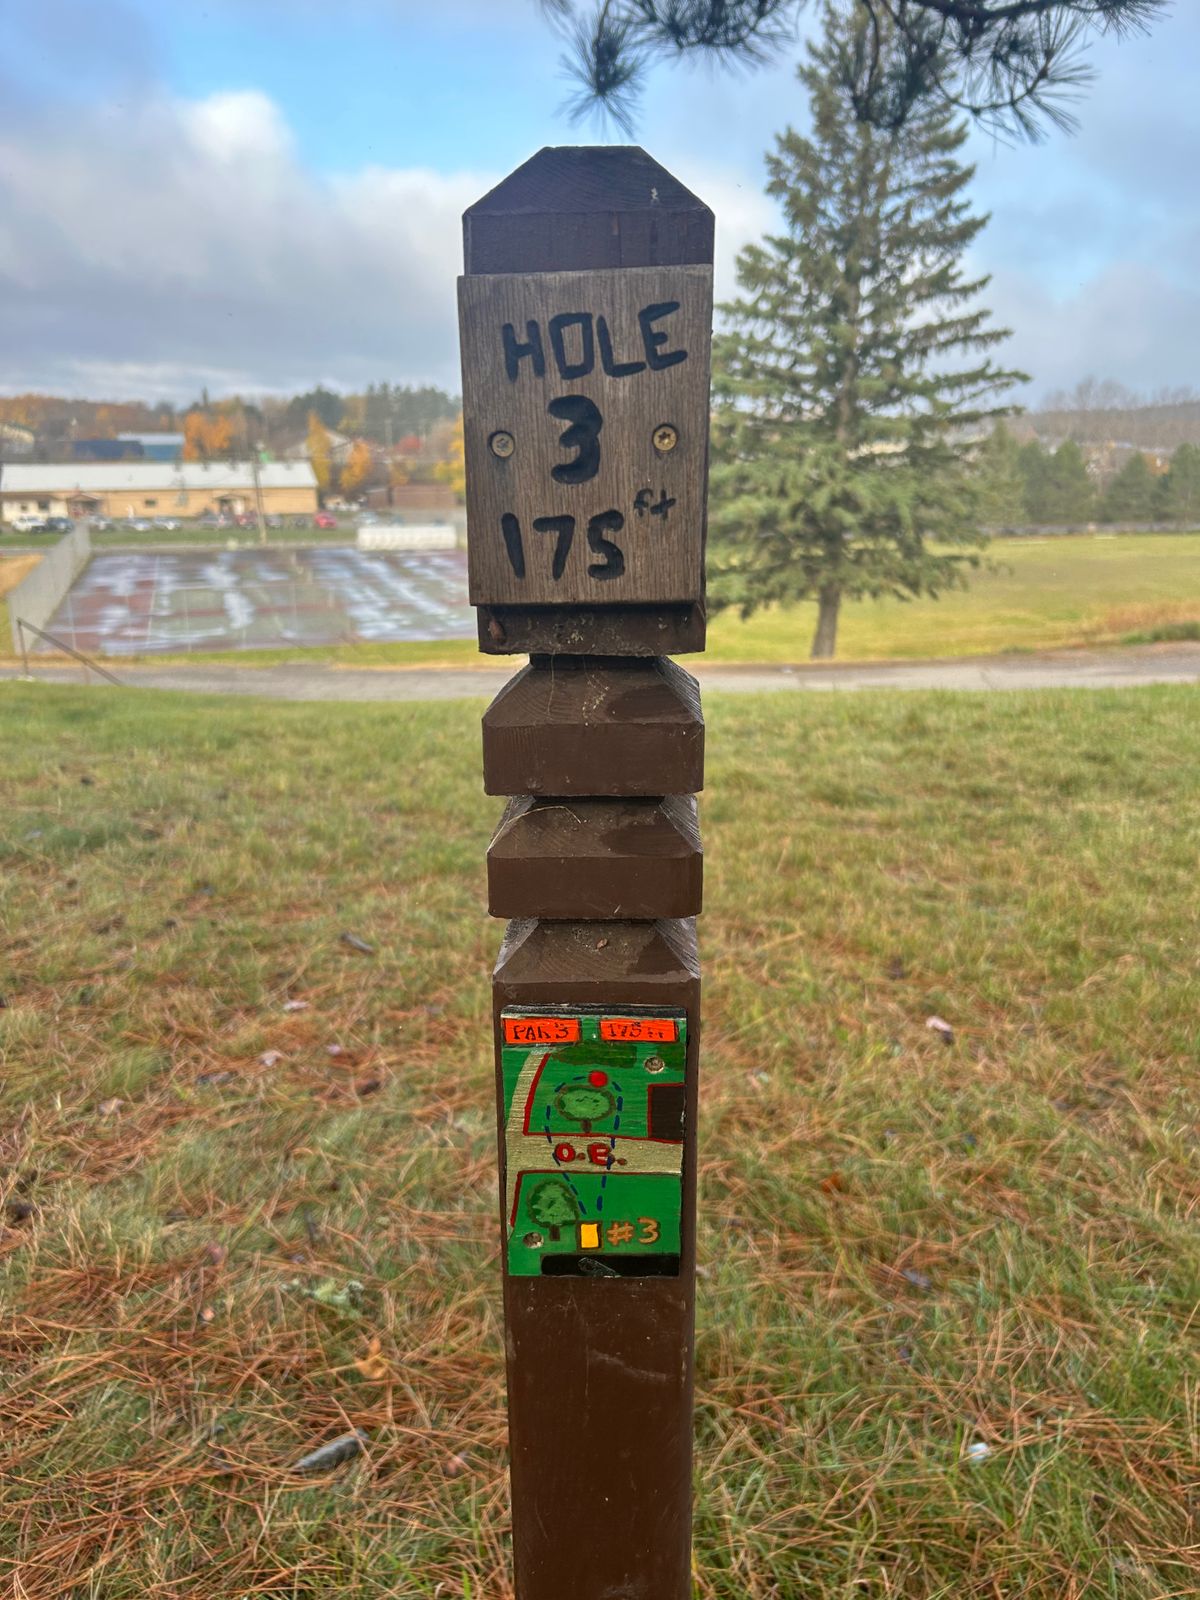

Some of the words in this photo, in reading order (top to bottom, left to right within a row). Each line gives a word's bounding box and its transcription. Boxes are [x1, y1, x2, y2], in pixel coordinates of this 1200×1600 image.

[502, 301, 687, 381] HOLE
[547, 394, 602, 485] 3
[501, 509, 624, 580] 175
[513, 1024, 550, 1040] PAR
[554, 1023, 569, 1039] 3
